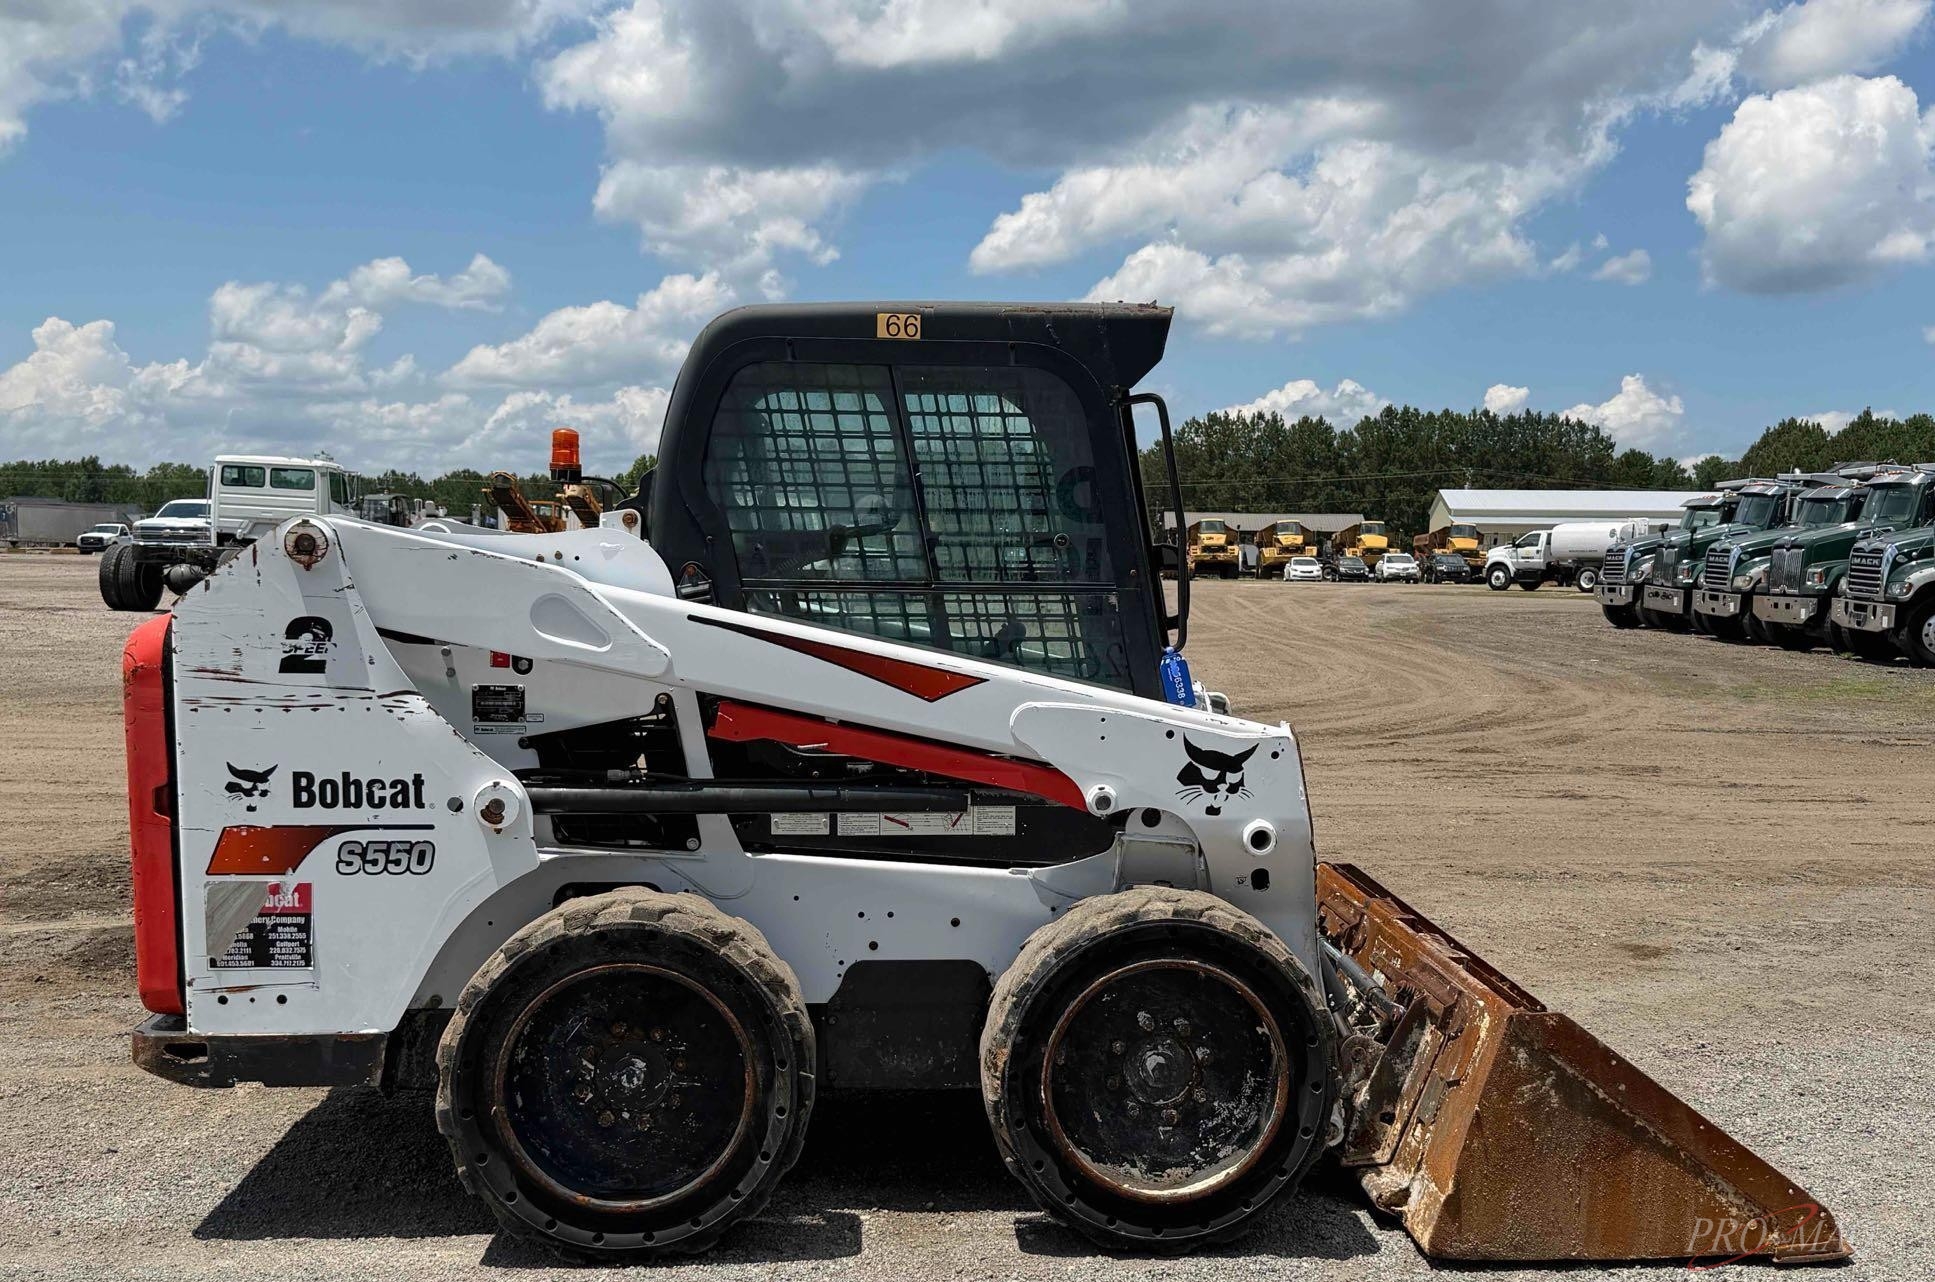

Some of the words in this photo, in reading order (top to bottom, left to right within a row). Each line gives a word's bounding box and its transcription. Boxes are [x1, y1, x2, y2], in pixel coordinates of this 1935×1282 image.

[886, 314, 919, 338] 66
[1851, 557, 1880, 566] MACK
[278, 616, 333, 674] 2
[292, 771, 425, 809] Bobcat
[336, 840, 436, 876] S550
[271, 916, 306, 925] Company
